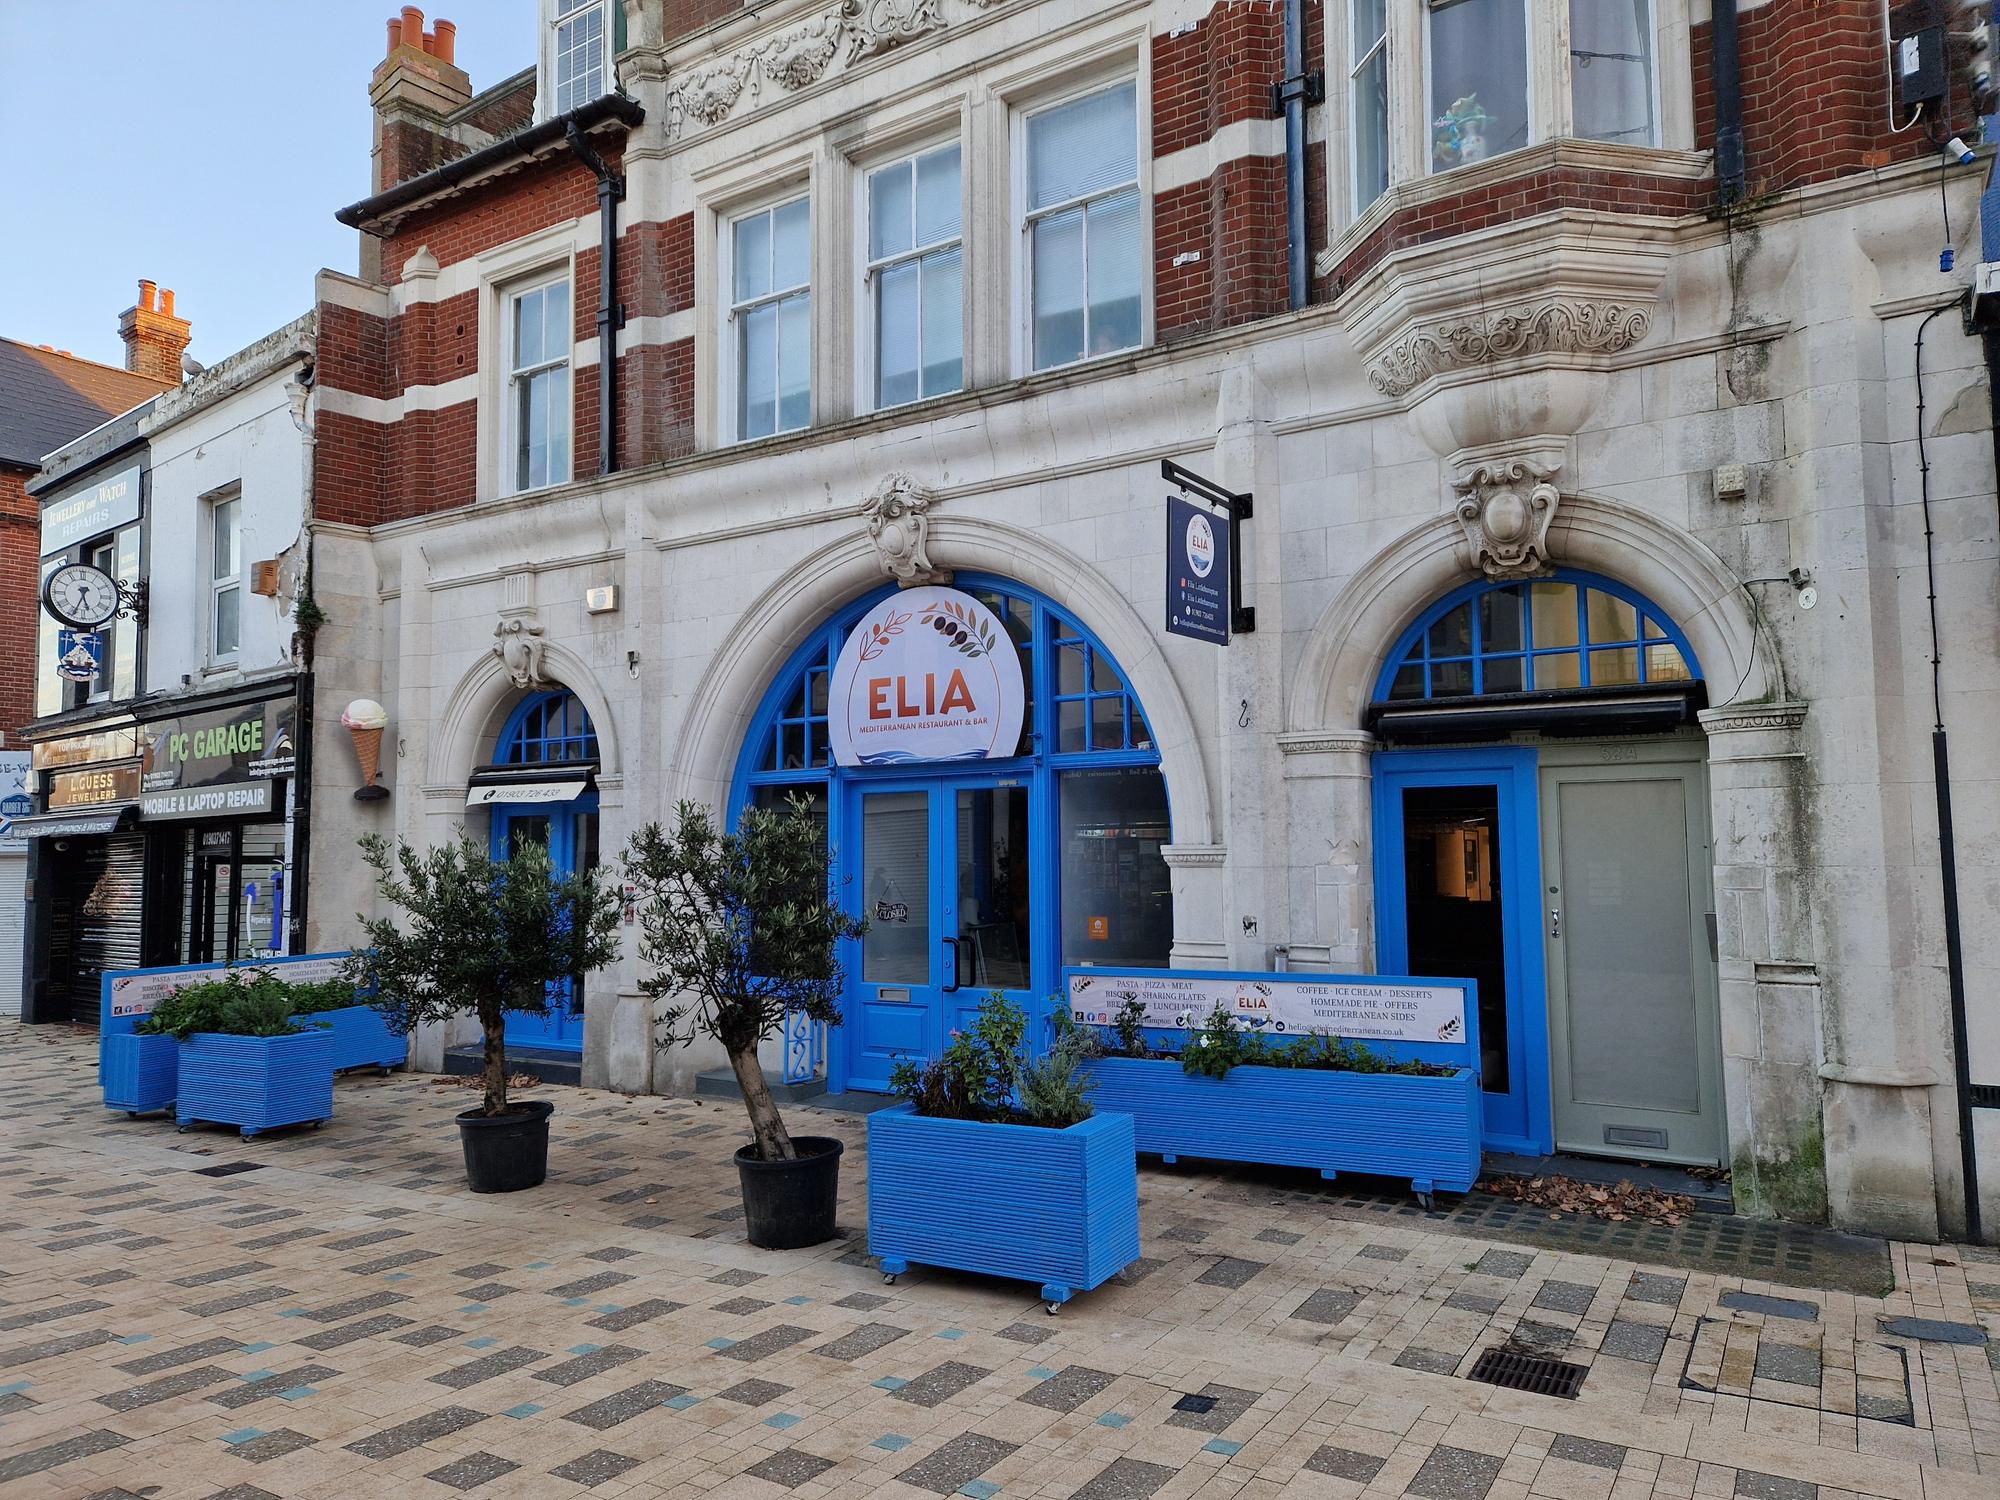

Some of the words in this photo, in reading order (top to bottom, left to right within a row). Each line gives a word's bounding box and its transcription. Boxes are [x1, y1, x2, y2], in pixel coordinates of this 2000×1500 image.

[99, 481, 127, 503] WATCH
[62, 508, 109, 537] REPAIRS
[1192, 534, 1209, 552] ELIA
[869, 668, 977, 720] ELIA
[859, 722, 917, 734] MEDITERRANEAN
[918, 719, 963, 730] RESTAURANT
[965, 718, 972, 726] &
[973, 717, 988, 726] BAR
[169, 732, 189, 763] PC
[194, 720, 263, 760] GARAGE
[67, 789, 116, 803] JEWELLERS
[143, 796, 177, 814] MOBILE
[178, 797, 185, 811] &
[187, 791, 225, 811] LAPTOP
[227, 788, 265, 807] REPAIR
[879, 907, 906, 919] CLOSED
[1117, 980, 1139, 988] PASTA
[1144, 981, 1166, 989] PIZZA
[1171, 982, 1194, 990] MEAT
[1142, 992, 1177, 1001] SHARING
[1179, 993, 1207, 1001] PLATES
[1297, 986, 1329, 995] COFFEE
[1335, 988, 1350, 996] ICE
[1351, 988, 1382, 997] CREAM
[1389, 989, 1433, 999] DESSERTS
[1153, 1002, 1180, 1011] LUNCH
[1181, 1004, 1206, 1012] MENU
[1238, 997, 1268, 1009] ELIA
[1310, 998, 1362, 1008] HOMEMADE
[1364, 1000, 1378, 1009] PIE
[1384, 1001, 1418, 1010] OFFERS
[1313, 1009, 1389, 1020] MEDITERRANEAN
[1391, 1013, 1416, 1022] SIDES
